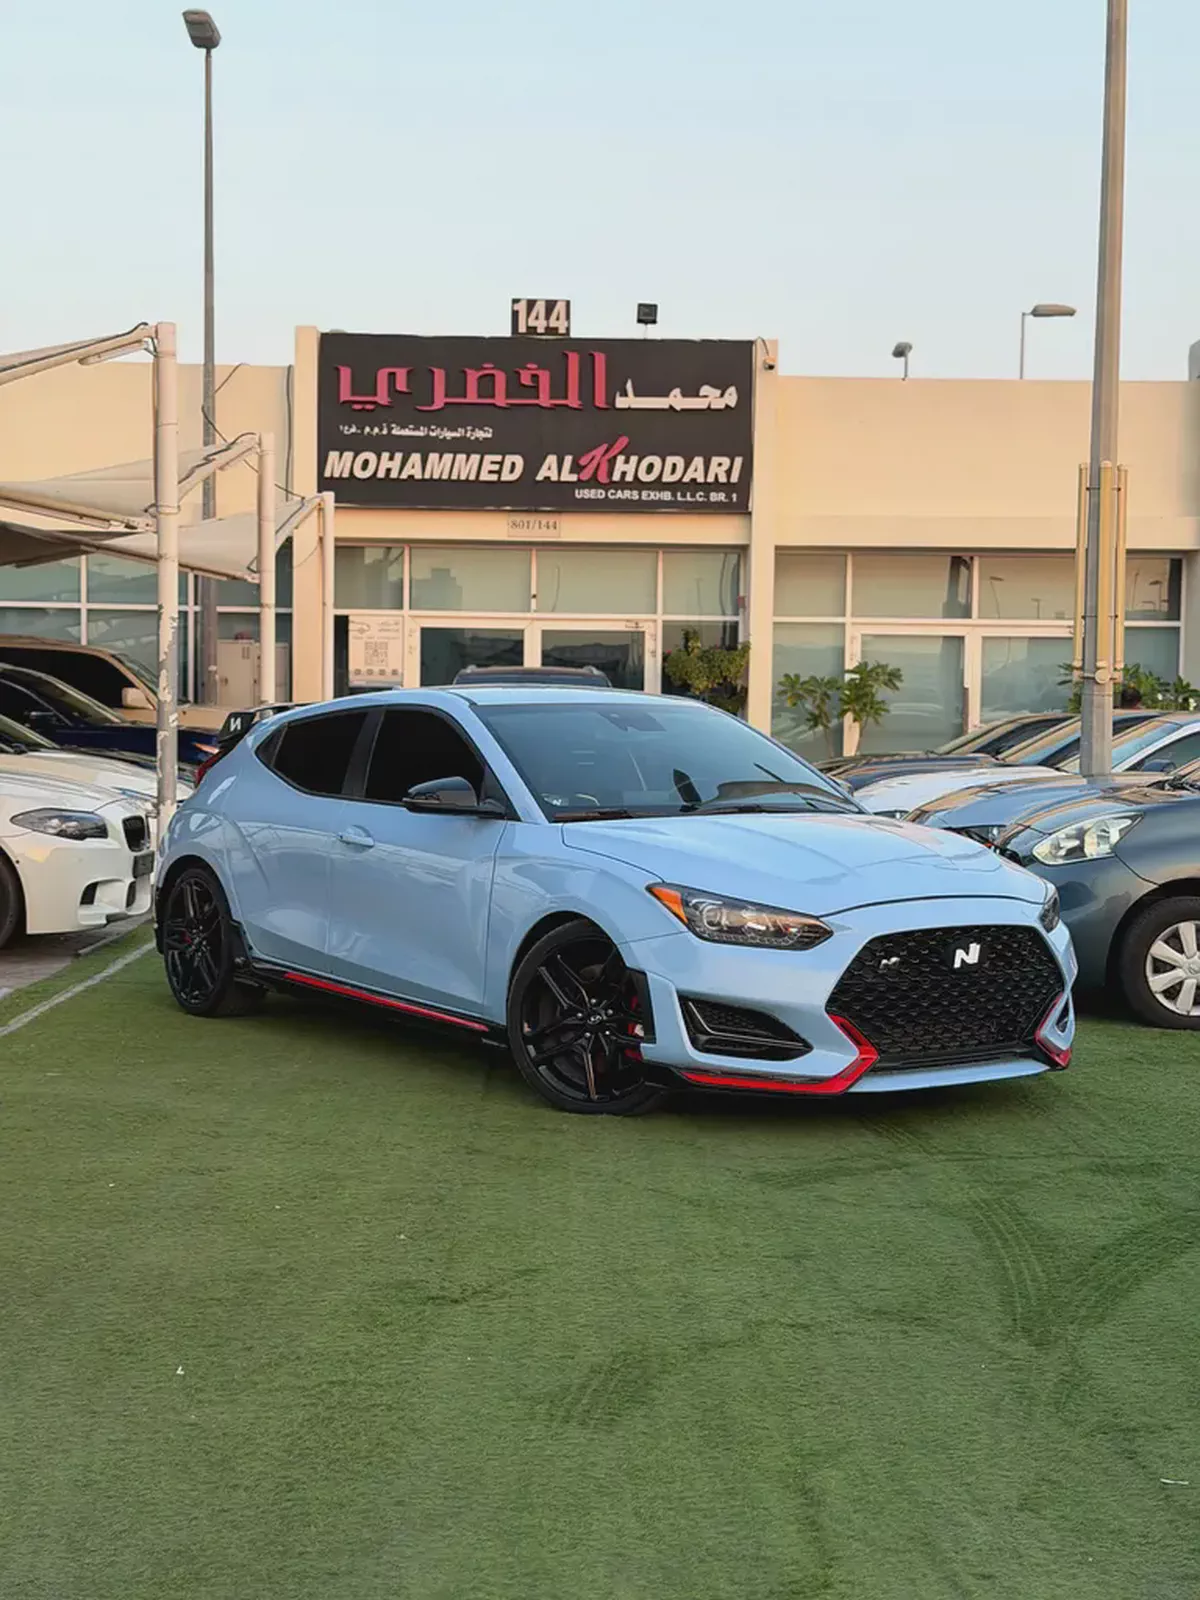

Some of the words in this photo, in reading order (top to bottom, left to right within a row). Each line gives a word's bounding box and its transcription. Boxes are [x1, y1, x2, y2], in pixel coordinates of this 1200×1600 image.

[513, 299, 568, 334] 144
[335, 350, 611, 411] الخضري
[615, 378, 738, 412] محمد
[429, 425, 464, 440] السيارات
[324, 451, 524, 482] MOHAMMED
[575, 489, 605, 499] USED
[607, 489, 639, 500] CARS
[641, 490, 674, 501] EXHB.
[709, 492, 728, 502] BR.
[731, 493, 737, 502] 1
[510, 519, 557, 530] 801/144
[954, 942, 980, 968] N
